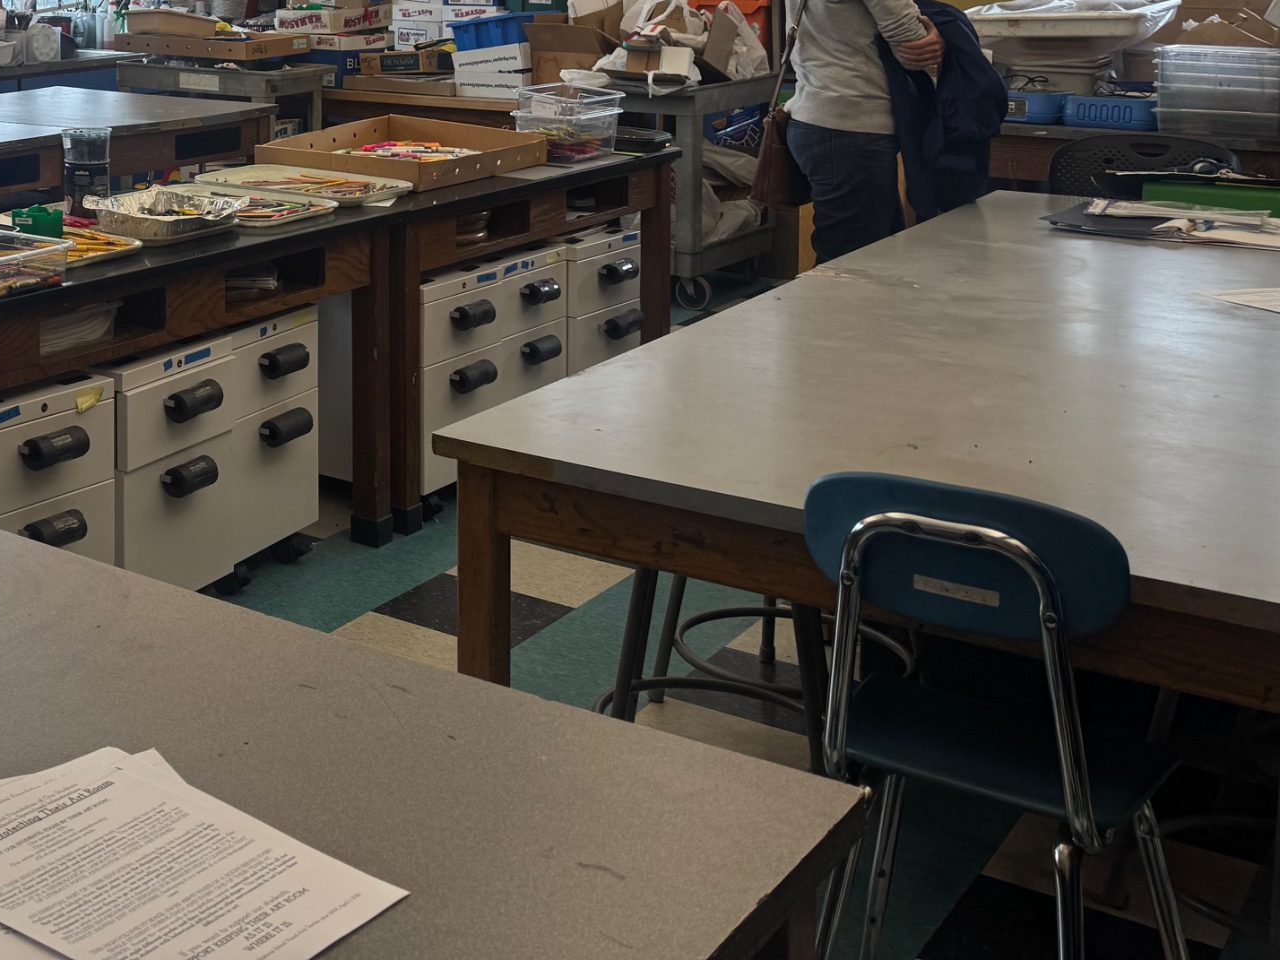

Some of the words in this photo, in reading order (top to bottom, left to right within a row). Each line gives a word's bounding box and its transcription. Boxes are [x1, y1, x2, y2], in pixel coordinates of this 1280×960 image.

[38, 802, 69, 816] Their
[68, 793, 88, 803] Art
[83, 780, 114, 795] Room
[213, 926, 248, 947] KEEPING
[245, 911, 270, 926] THEIR
[269, 901, 285, 912] ART
[283, 887, 309, 903] ROOM
[228, 912, 251, 928] support
[243, 932, 256, 941] AS
[252, 926, 264, 934] IT
[243, 932, 275, 950] WHERE
